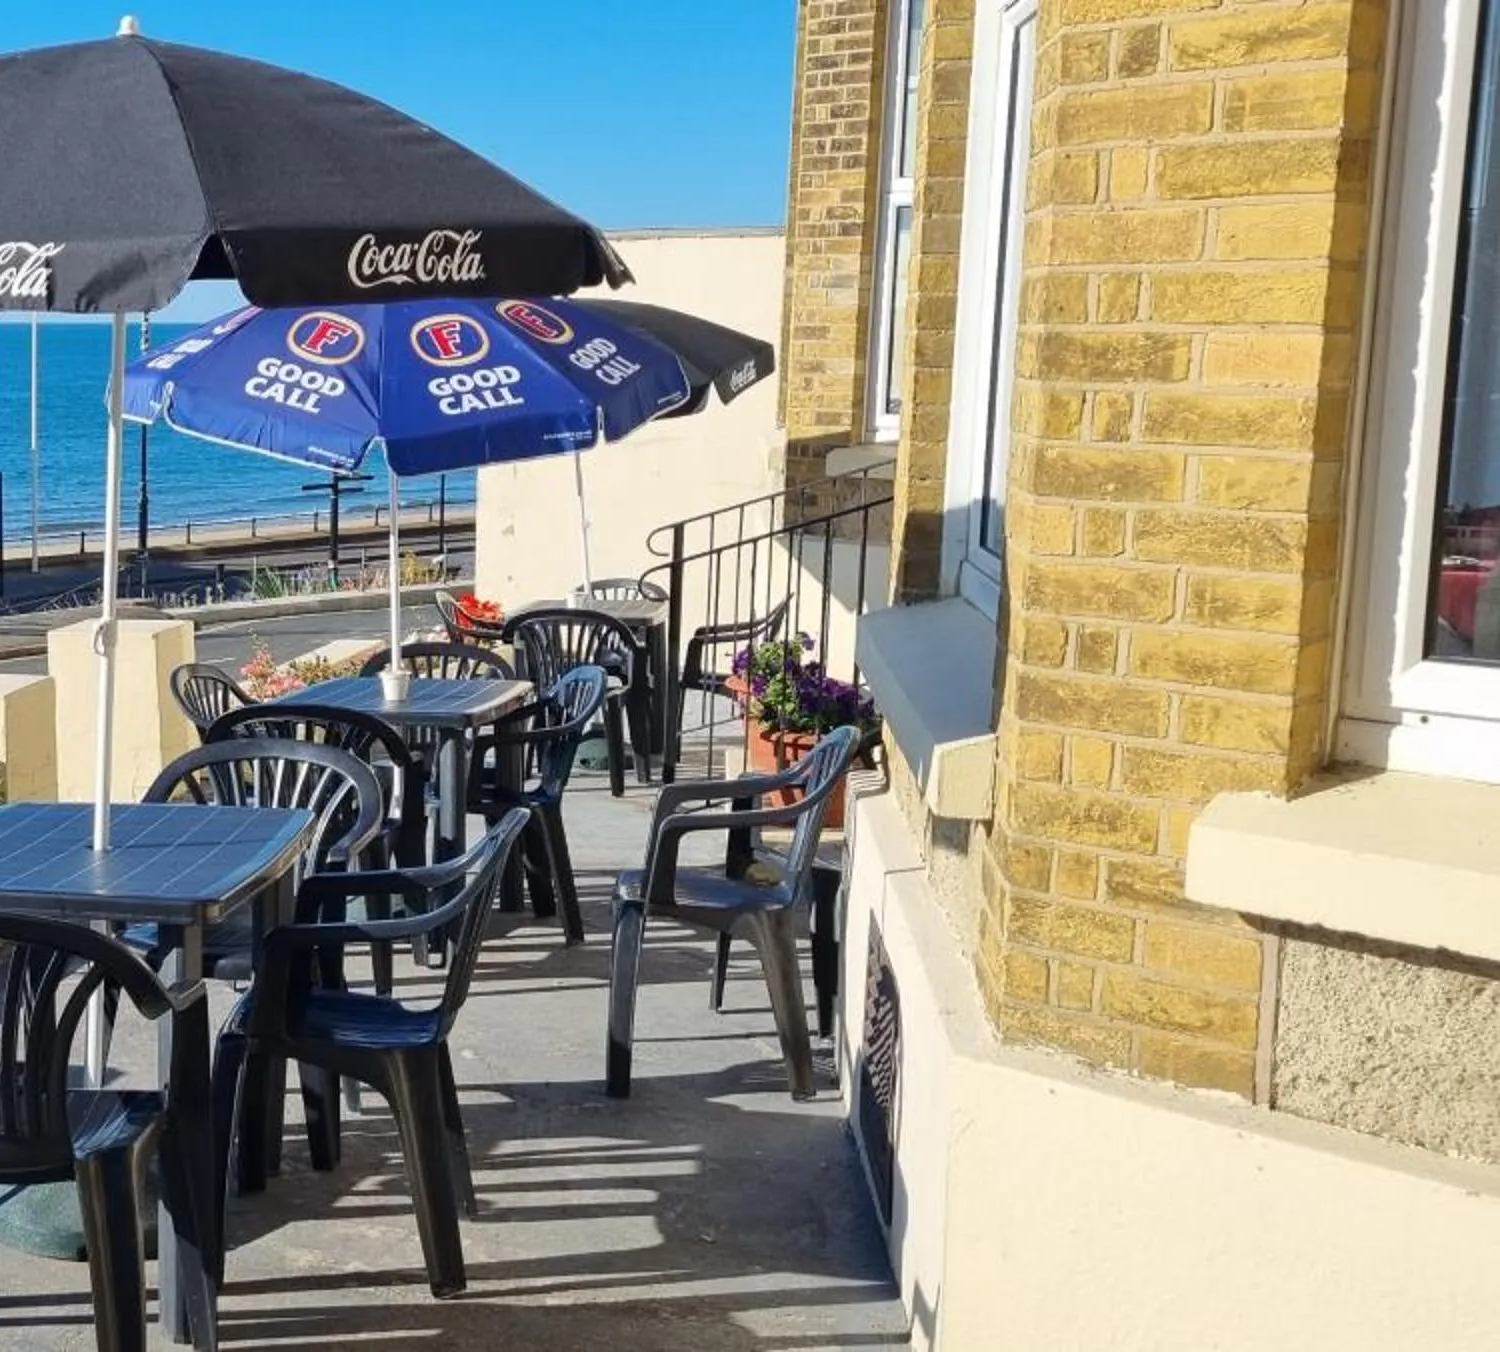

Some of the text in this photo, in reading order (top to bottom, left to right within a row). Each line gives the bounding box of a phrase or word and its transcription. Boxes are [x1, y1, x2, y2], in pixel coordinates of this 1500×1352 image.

[347, 229, 487, 288] Coca-Cola
[301, 319, 353, 354] F
[425, 321, 462, 359] F
[569, 337, 617, 369] GOOD
[257, 357, 345, 397] GOOD
[428, 365, 521, 396] GOOD
[595, 355, 641, 385] CALL
[245, 377, 320, 414] CALL
[439, 387, 525, 415] CALL
